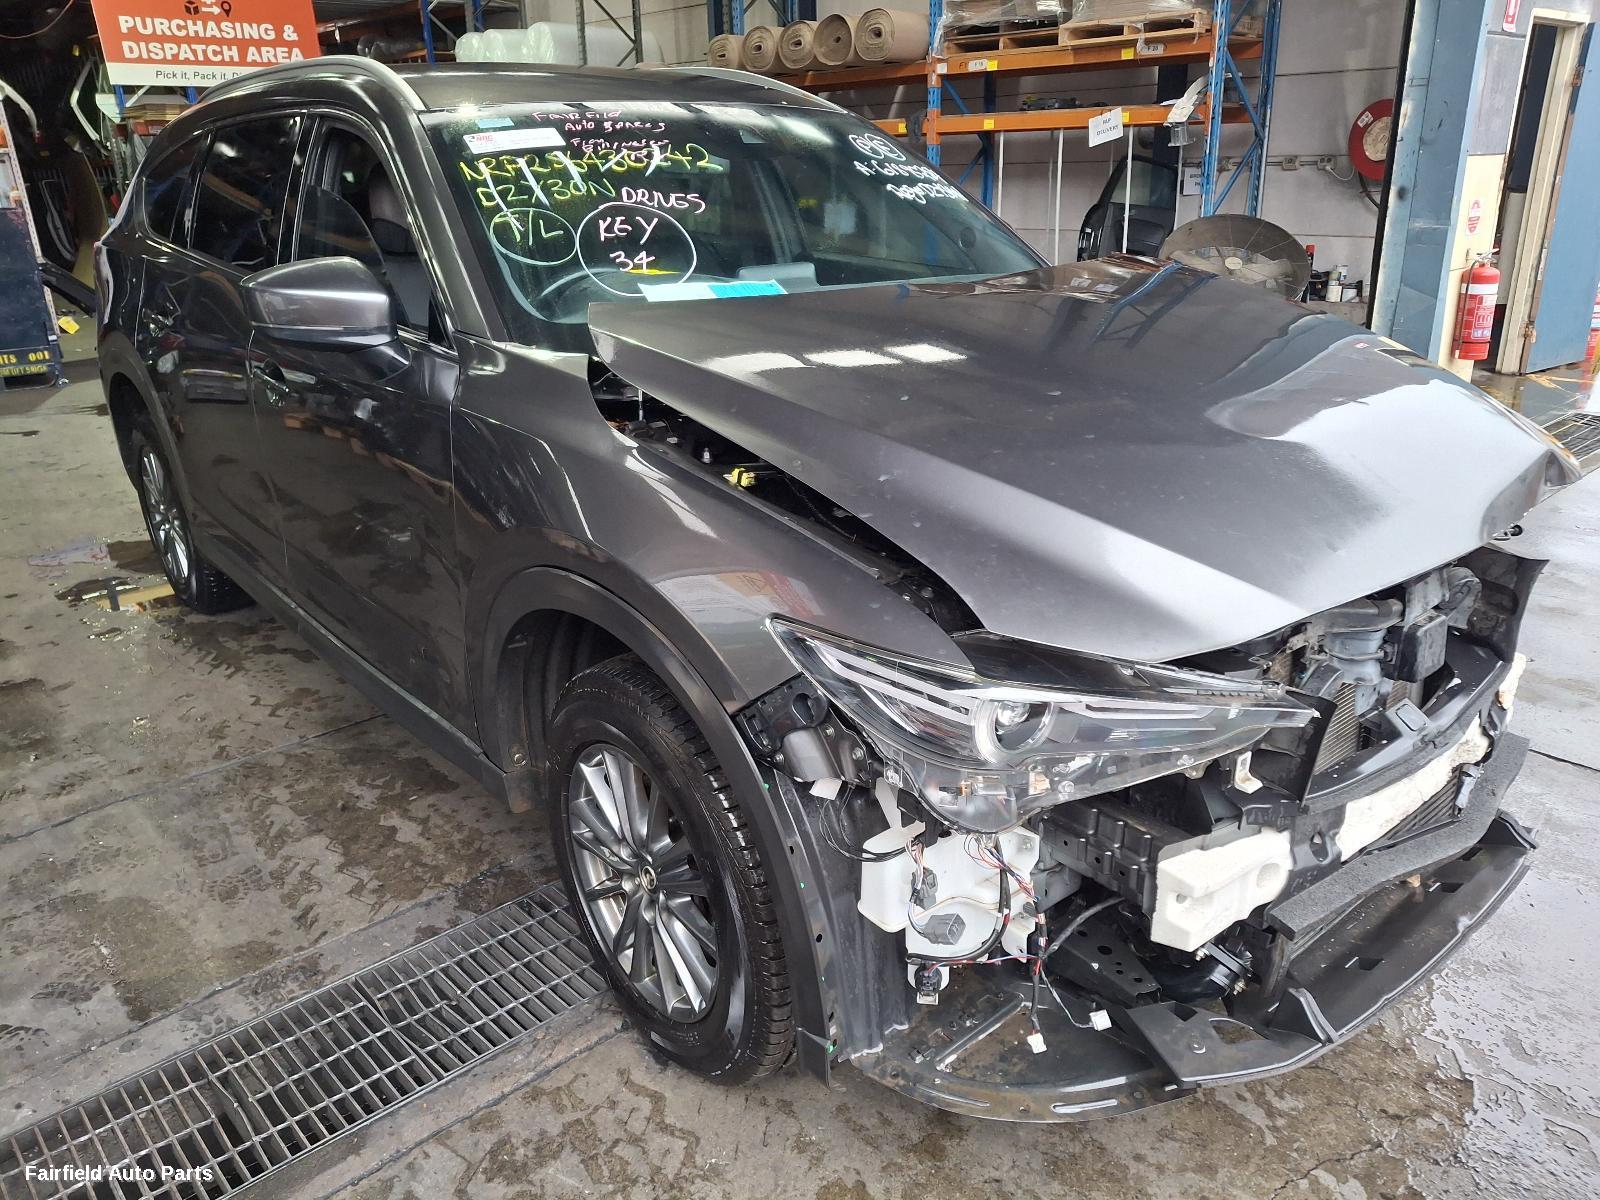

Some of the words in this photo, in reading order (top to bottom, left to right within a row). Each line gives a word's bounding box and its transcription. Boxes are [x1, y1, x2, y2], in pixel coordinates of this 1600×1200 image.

[118, 15, 276, 41] PURCHASING
[283, 24, 299, 41] &
[121, 41, 240, 63] DISPATCH
[246, 47, 305, 64] AREA
[155, 70, 179, 80] Pick
[181, 71, 191, 81] it,
[193, 71, 217, 81] Pack
[621, 186, 706, 214] DRIVES
[599, 216, 659, 246] KEY
[610, 250, 656, 272] 34
